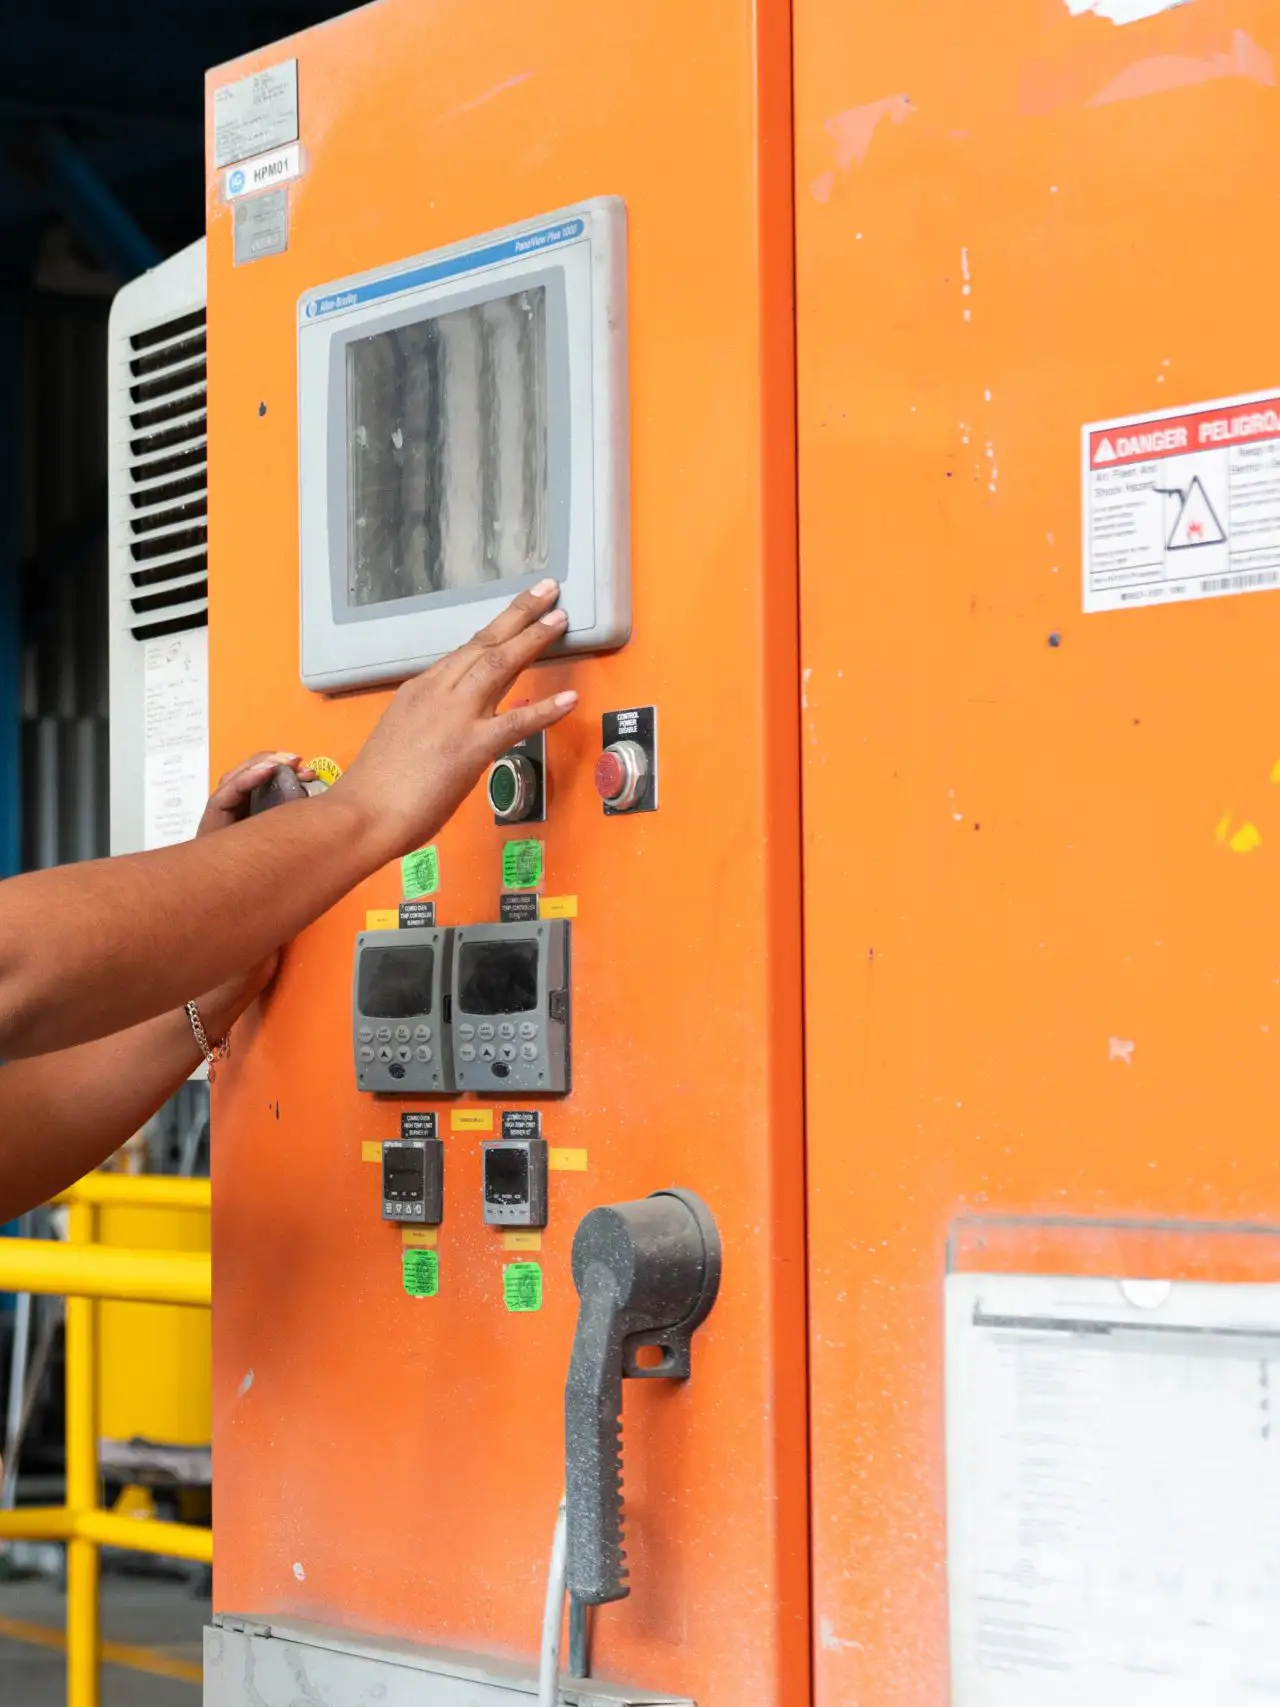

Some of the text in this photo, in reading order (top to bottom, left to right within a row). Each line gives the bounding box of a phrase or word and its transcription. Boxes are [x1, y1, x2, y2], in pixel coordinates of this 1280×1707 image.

[253, 158, 289, 182] HPM01
[1116, 410, 1278, 457] DANGER PELIGRO
[616, 711, 640, 721] CONTROL
[619, 719, 638, 728] POWER
[618, 726, 638, 735] DISABLE
